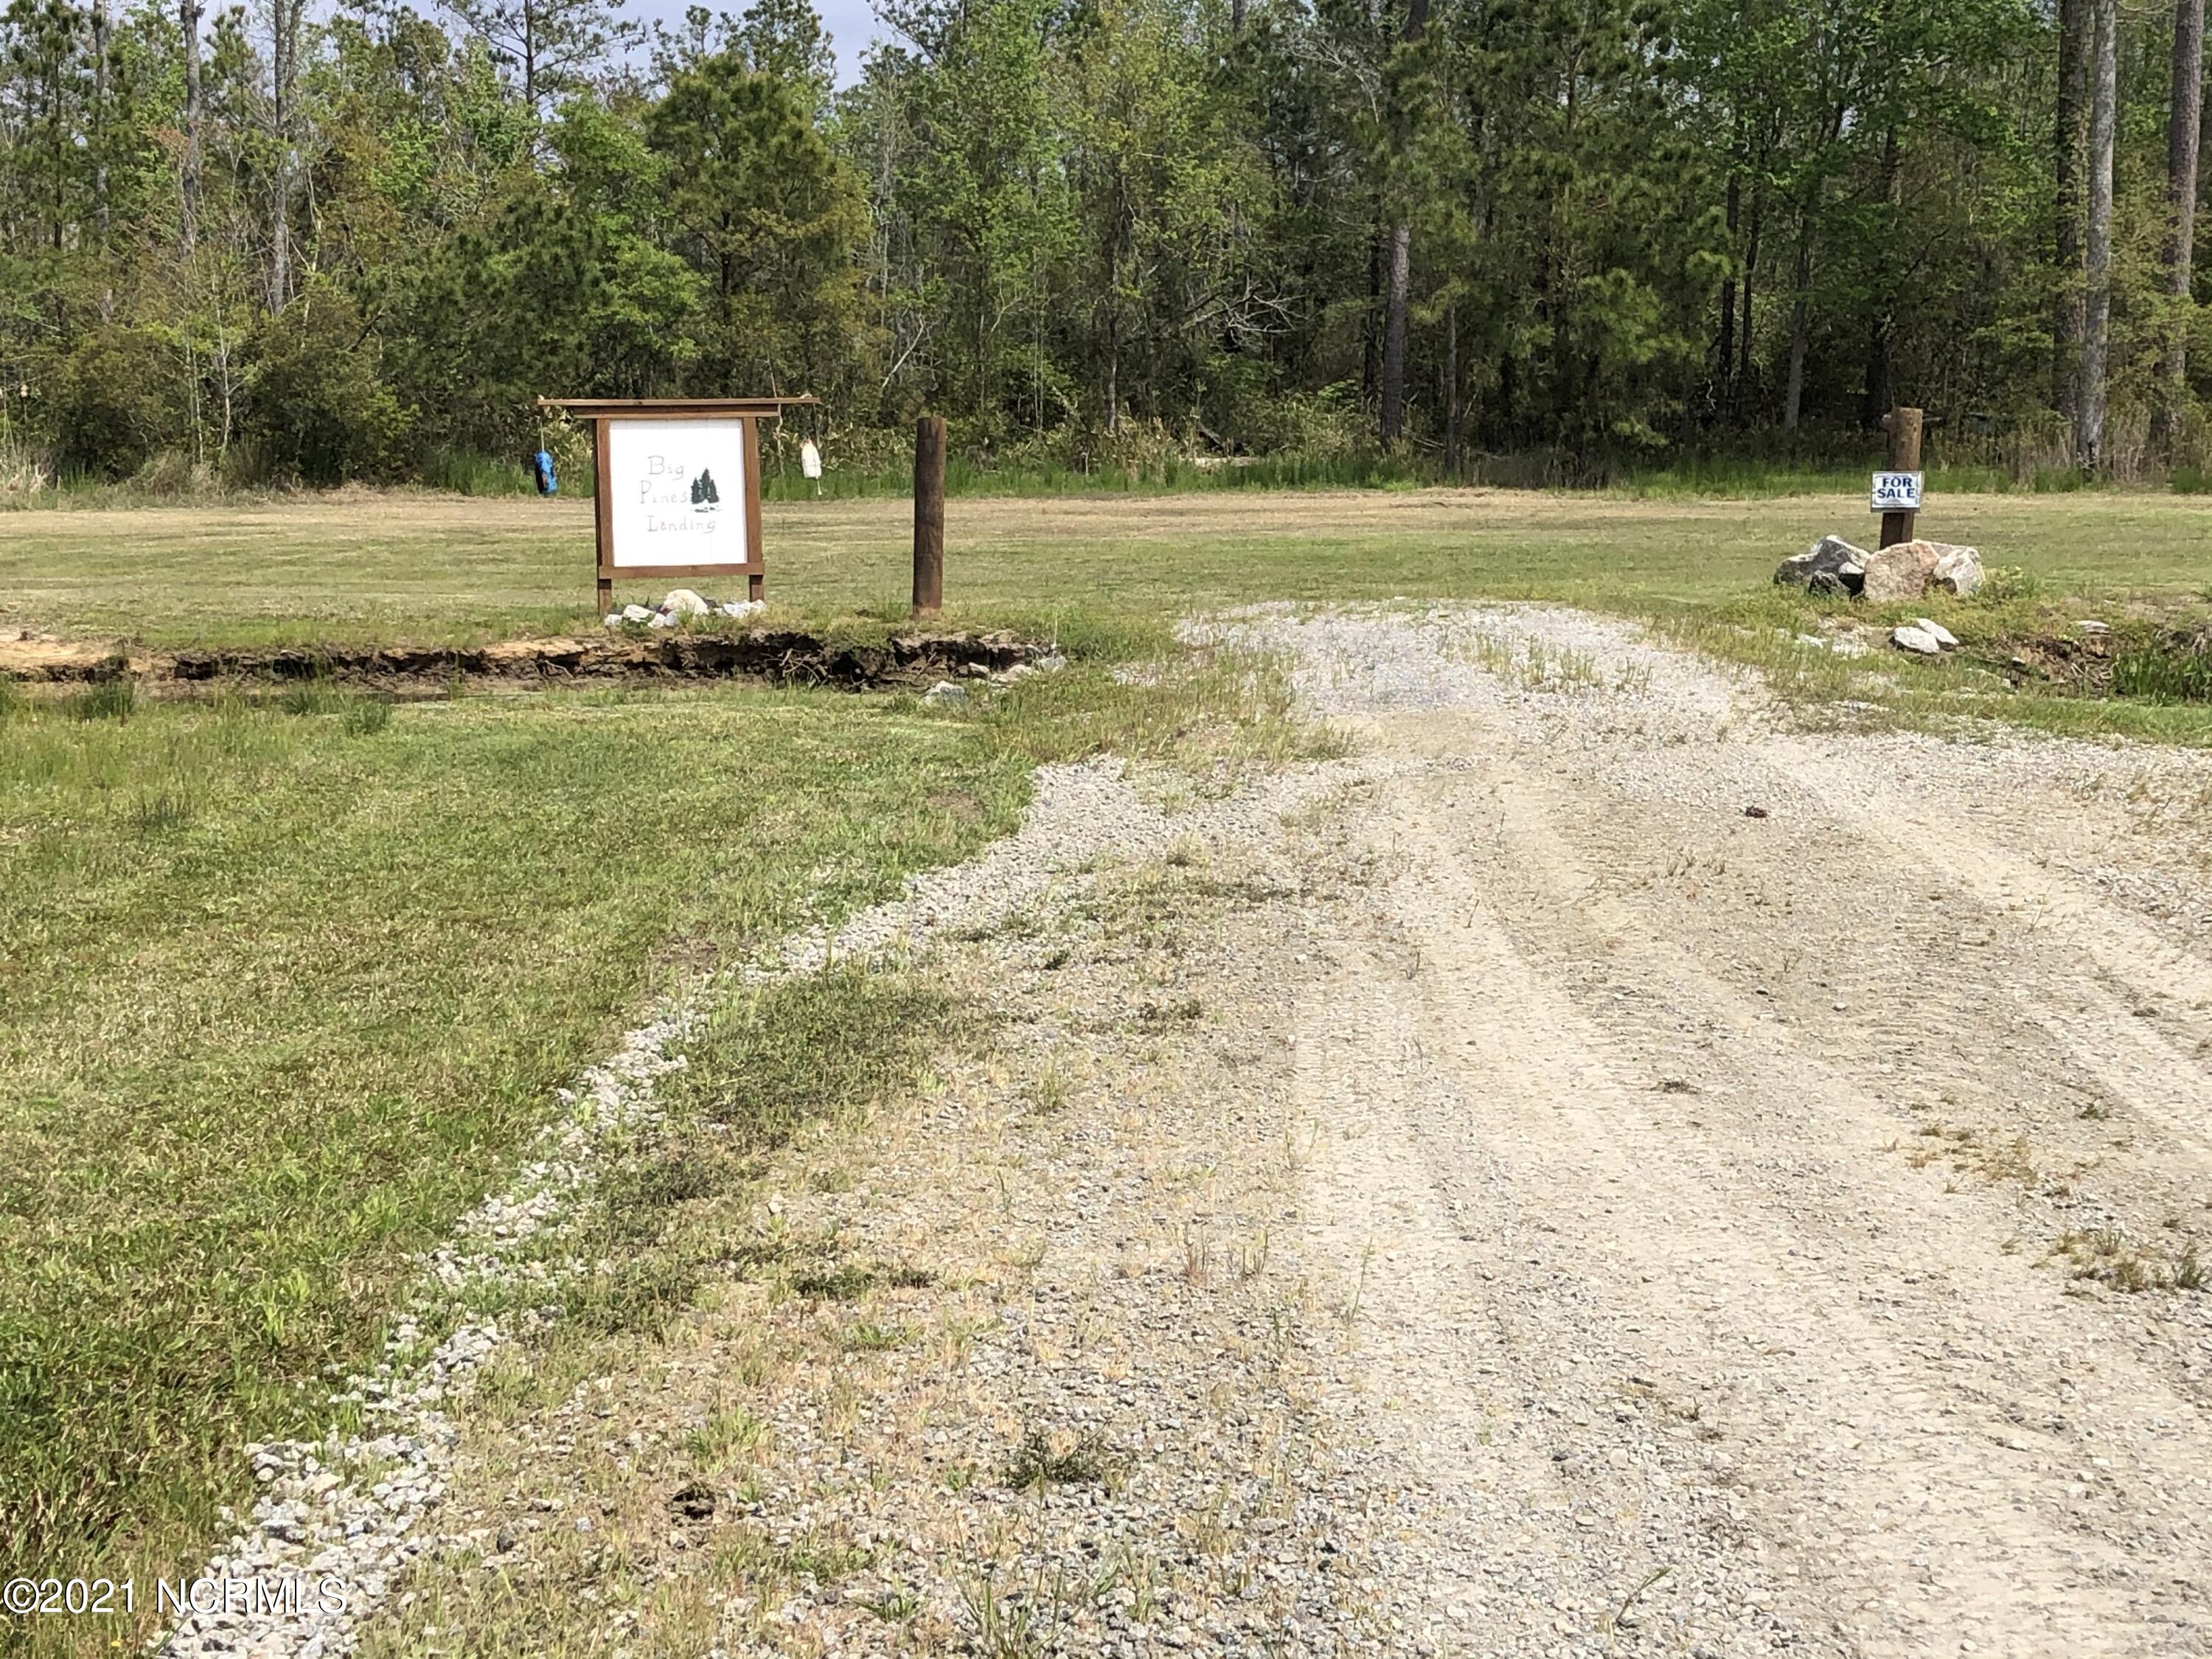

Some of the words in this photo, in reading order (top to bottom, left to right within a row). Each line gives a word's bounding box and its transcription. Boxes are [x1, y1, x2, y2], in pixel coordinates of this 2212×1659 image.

[647, 455, 684, 481] Big
[1882, 477, 1913, 487] FOR
[639, 480, 688, 504] Pines
[1877, 488, 1916, 498] SALE
[647, 515, 716, 534] Landing
